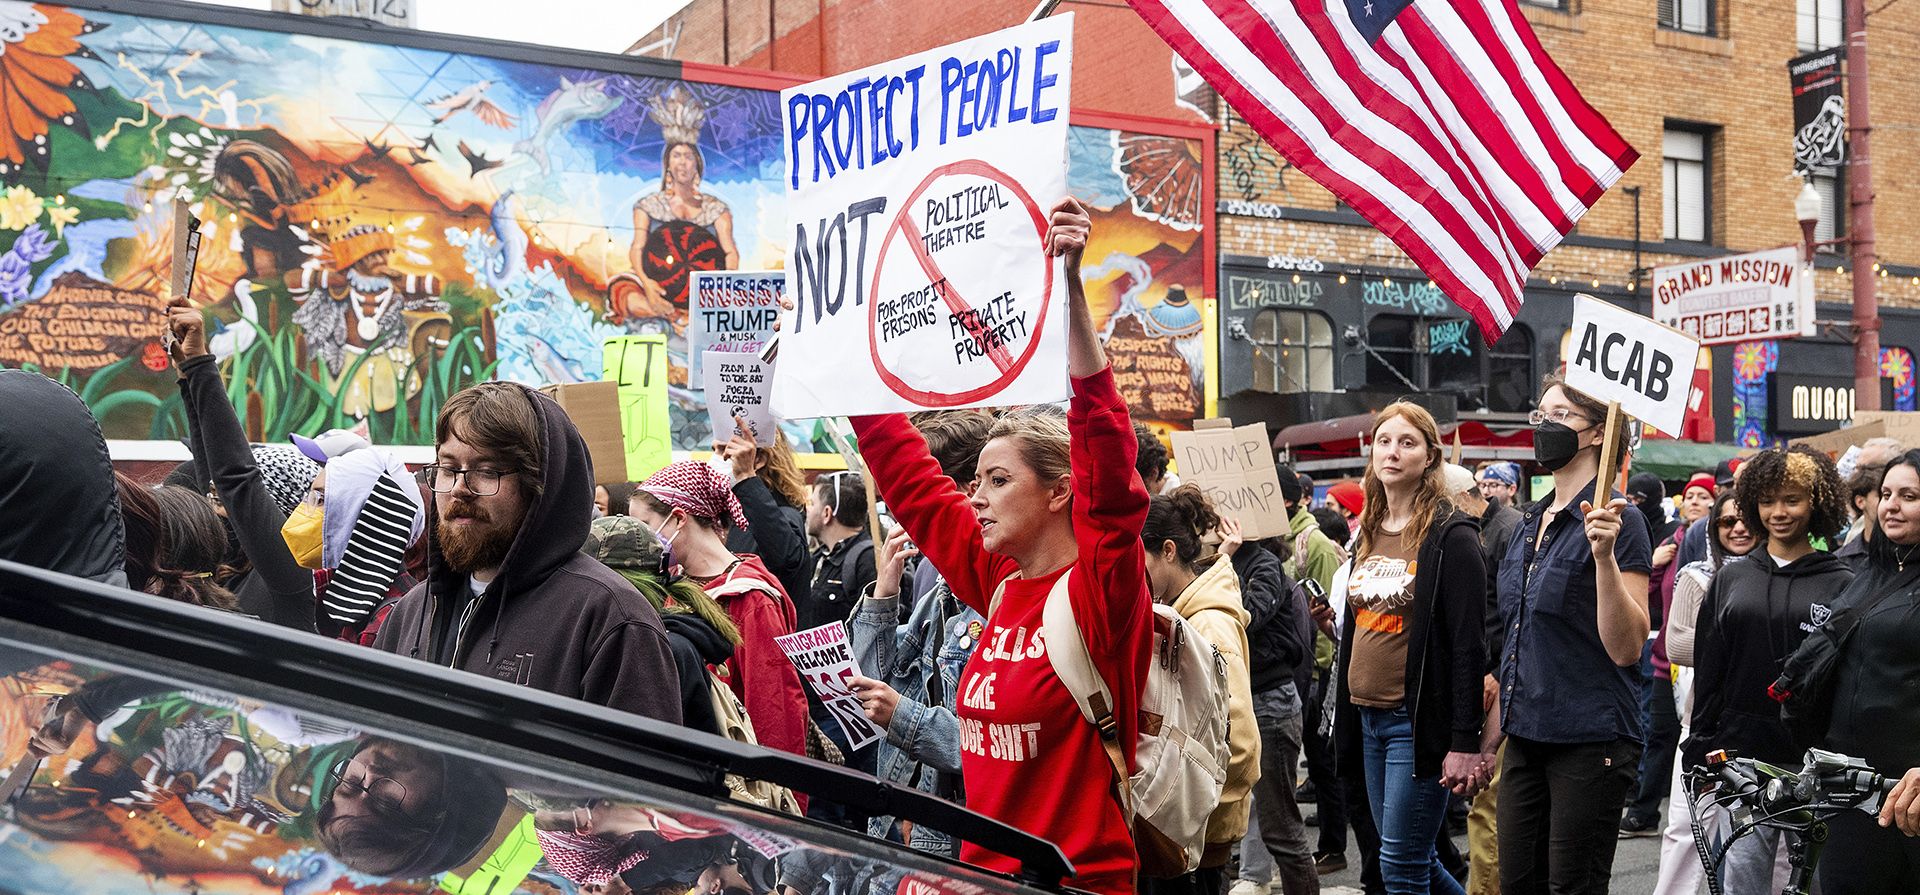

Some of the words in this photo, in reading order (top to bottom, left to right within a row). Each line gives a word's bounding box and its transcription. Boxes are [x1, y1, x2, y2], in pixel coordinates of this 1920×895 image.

[788, 65, 925, 190] PROTECT
[939, 40, 1060, 145] PEOPLE
[926, 183, 1009, 231] POLITICAL
[921, 220, 986, 257] THEATRE
[795, 197, 887, 334] NOT
[1658, 264, 1713, 305] GRAND
[1721, 259, 1794, 289] MISSION
[24, 304, 55, 320] THE
[877, 278, 947, 322] FOR-PROFIT
[949, 290, 1016, 340] PRIVATE
[0, 318, 42, 334] OUR
[702, 310, 777, 332] TRUMP
[882, 305, 937, 342] PRISONS
[28, 333, 107, 354] FUTURE
[720, 333, 727, 342] &
[729, 332, 756, 342] MUSK
[954, 311, 1027, 364] PROPERTY
[1105, 336, 1170, 353] RESPECT
[720, 364, 745, 373] FROM
[1136, 356, 1182, 373] RIGHTS
[1575, 321, 1674, 402] ACAB
[720, 374, 731, 383] TO
[749, 374, 764, 383] BAY
[1148, 372, 1190, 391] MEANS
[720, 394, 762, 405] RACISTAS
[1185, 441, 1260, 475] DUMP
[1202, 482, 1276, 514] TRUMP
[777, 623, 845, 654] IMMIGRANTS
[789, 643, 854, 671] WELCOME,
[989, 722, 1042, 762] SHIT
